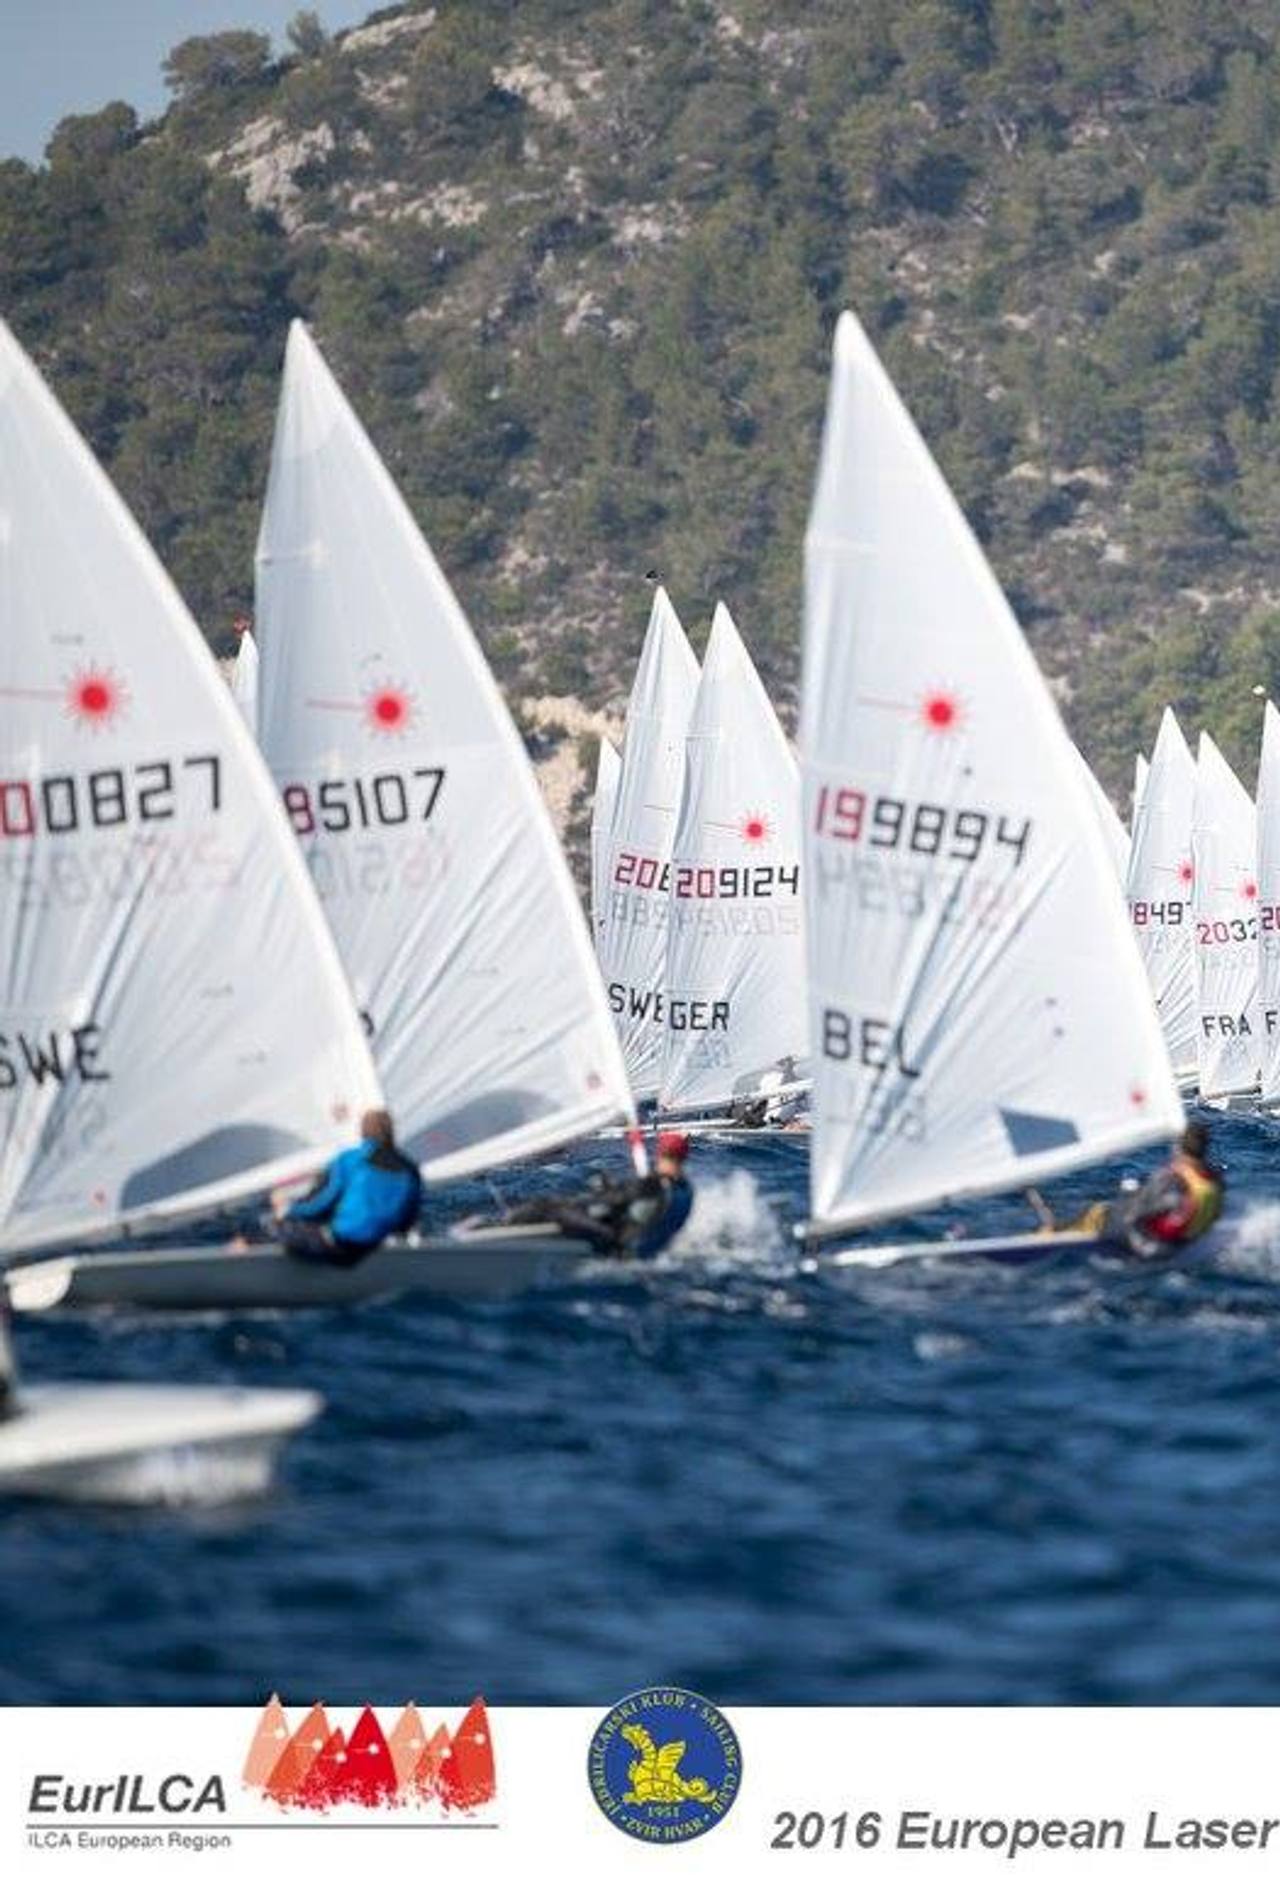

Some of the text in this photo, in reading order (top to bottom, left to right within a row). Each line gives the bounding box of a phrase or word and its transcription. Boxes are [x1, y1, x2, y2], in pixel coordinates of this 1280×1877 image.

[815, 787, 1030, 866] 199894
[676, 865, 799, 899] 209124
[1129, 902, 1191, 925] 849
[670, 1002, 729, 1031] GER
[1203, 1014, 1252, 1037] FRA
[824, 1009, 921, 1079] BEL
